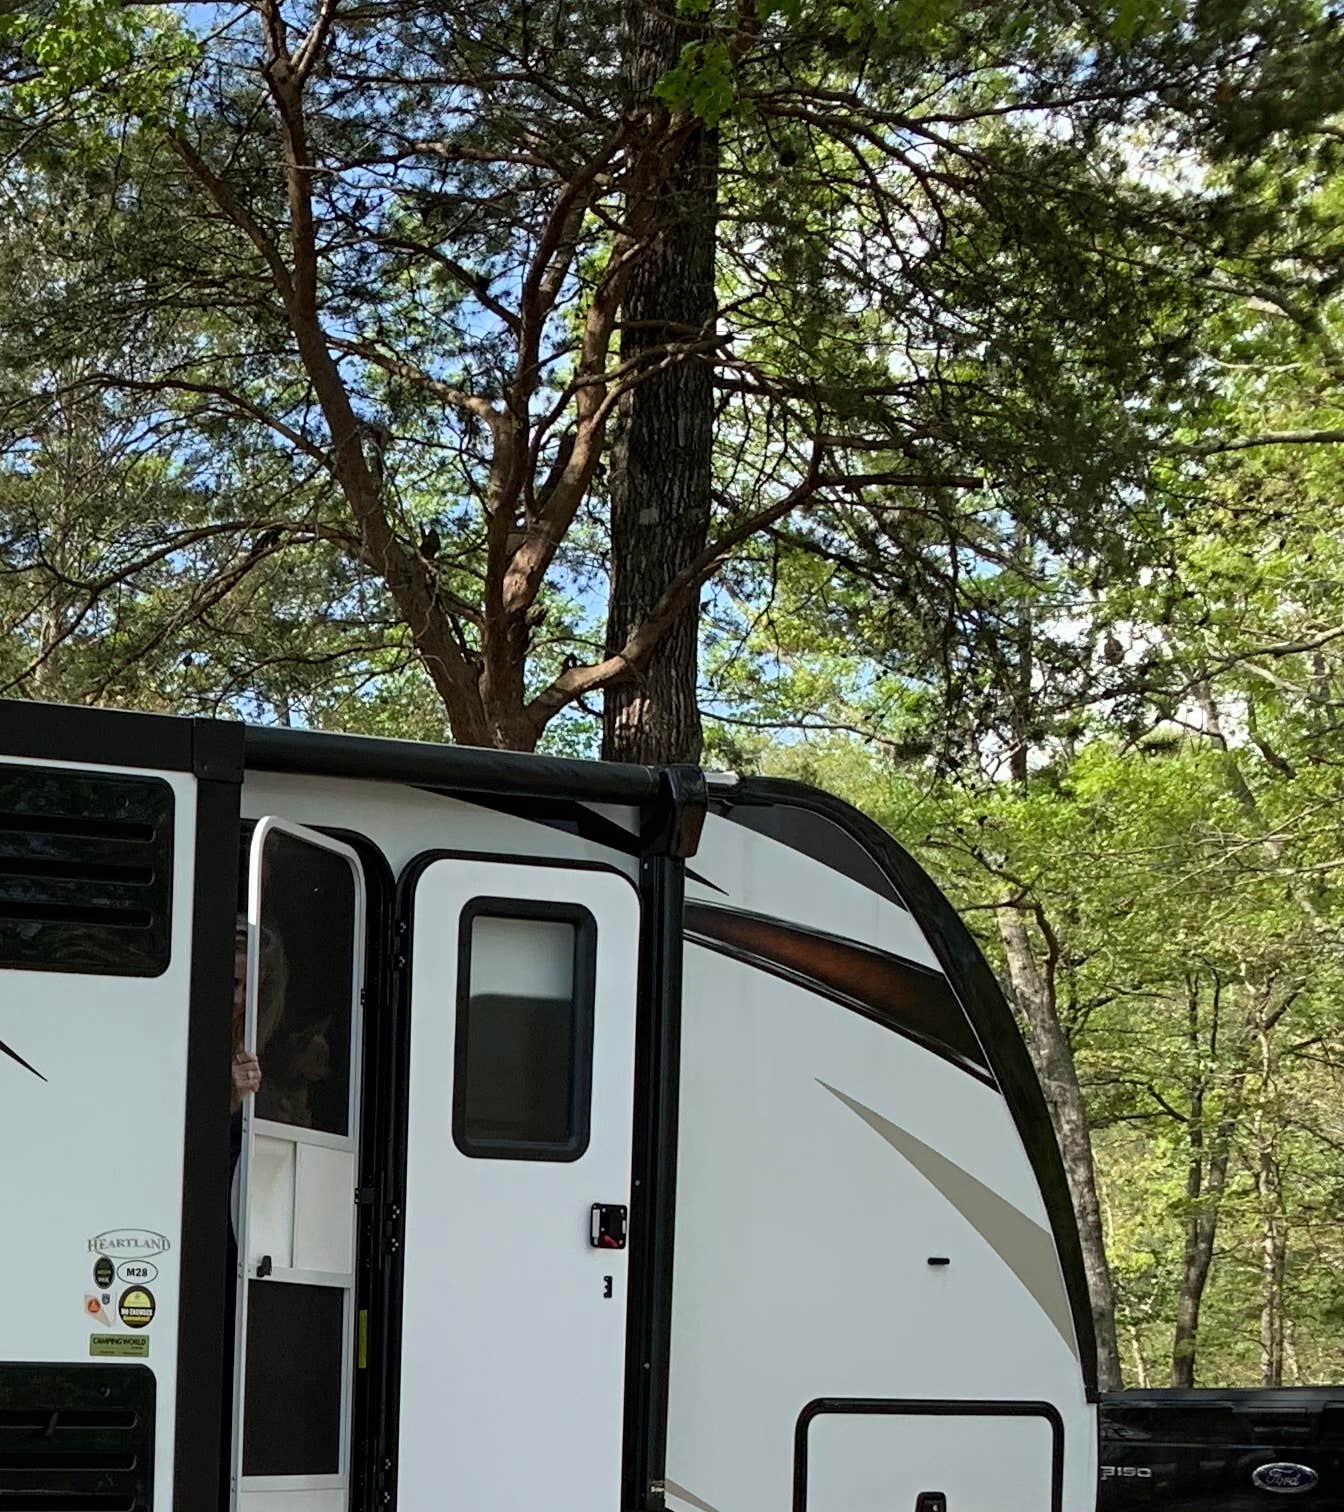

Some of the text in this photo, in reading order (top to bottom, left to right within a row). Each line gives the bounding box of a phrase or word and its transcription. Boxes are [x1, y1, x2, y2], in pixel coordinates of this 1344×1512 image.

[88, 1239, 171, 1252] HEARTLAND
[126, 1267, 148, 1277] M28
[1266, 1468, 1300, 1486] Ford
